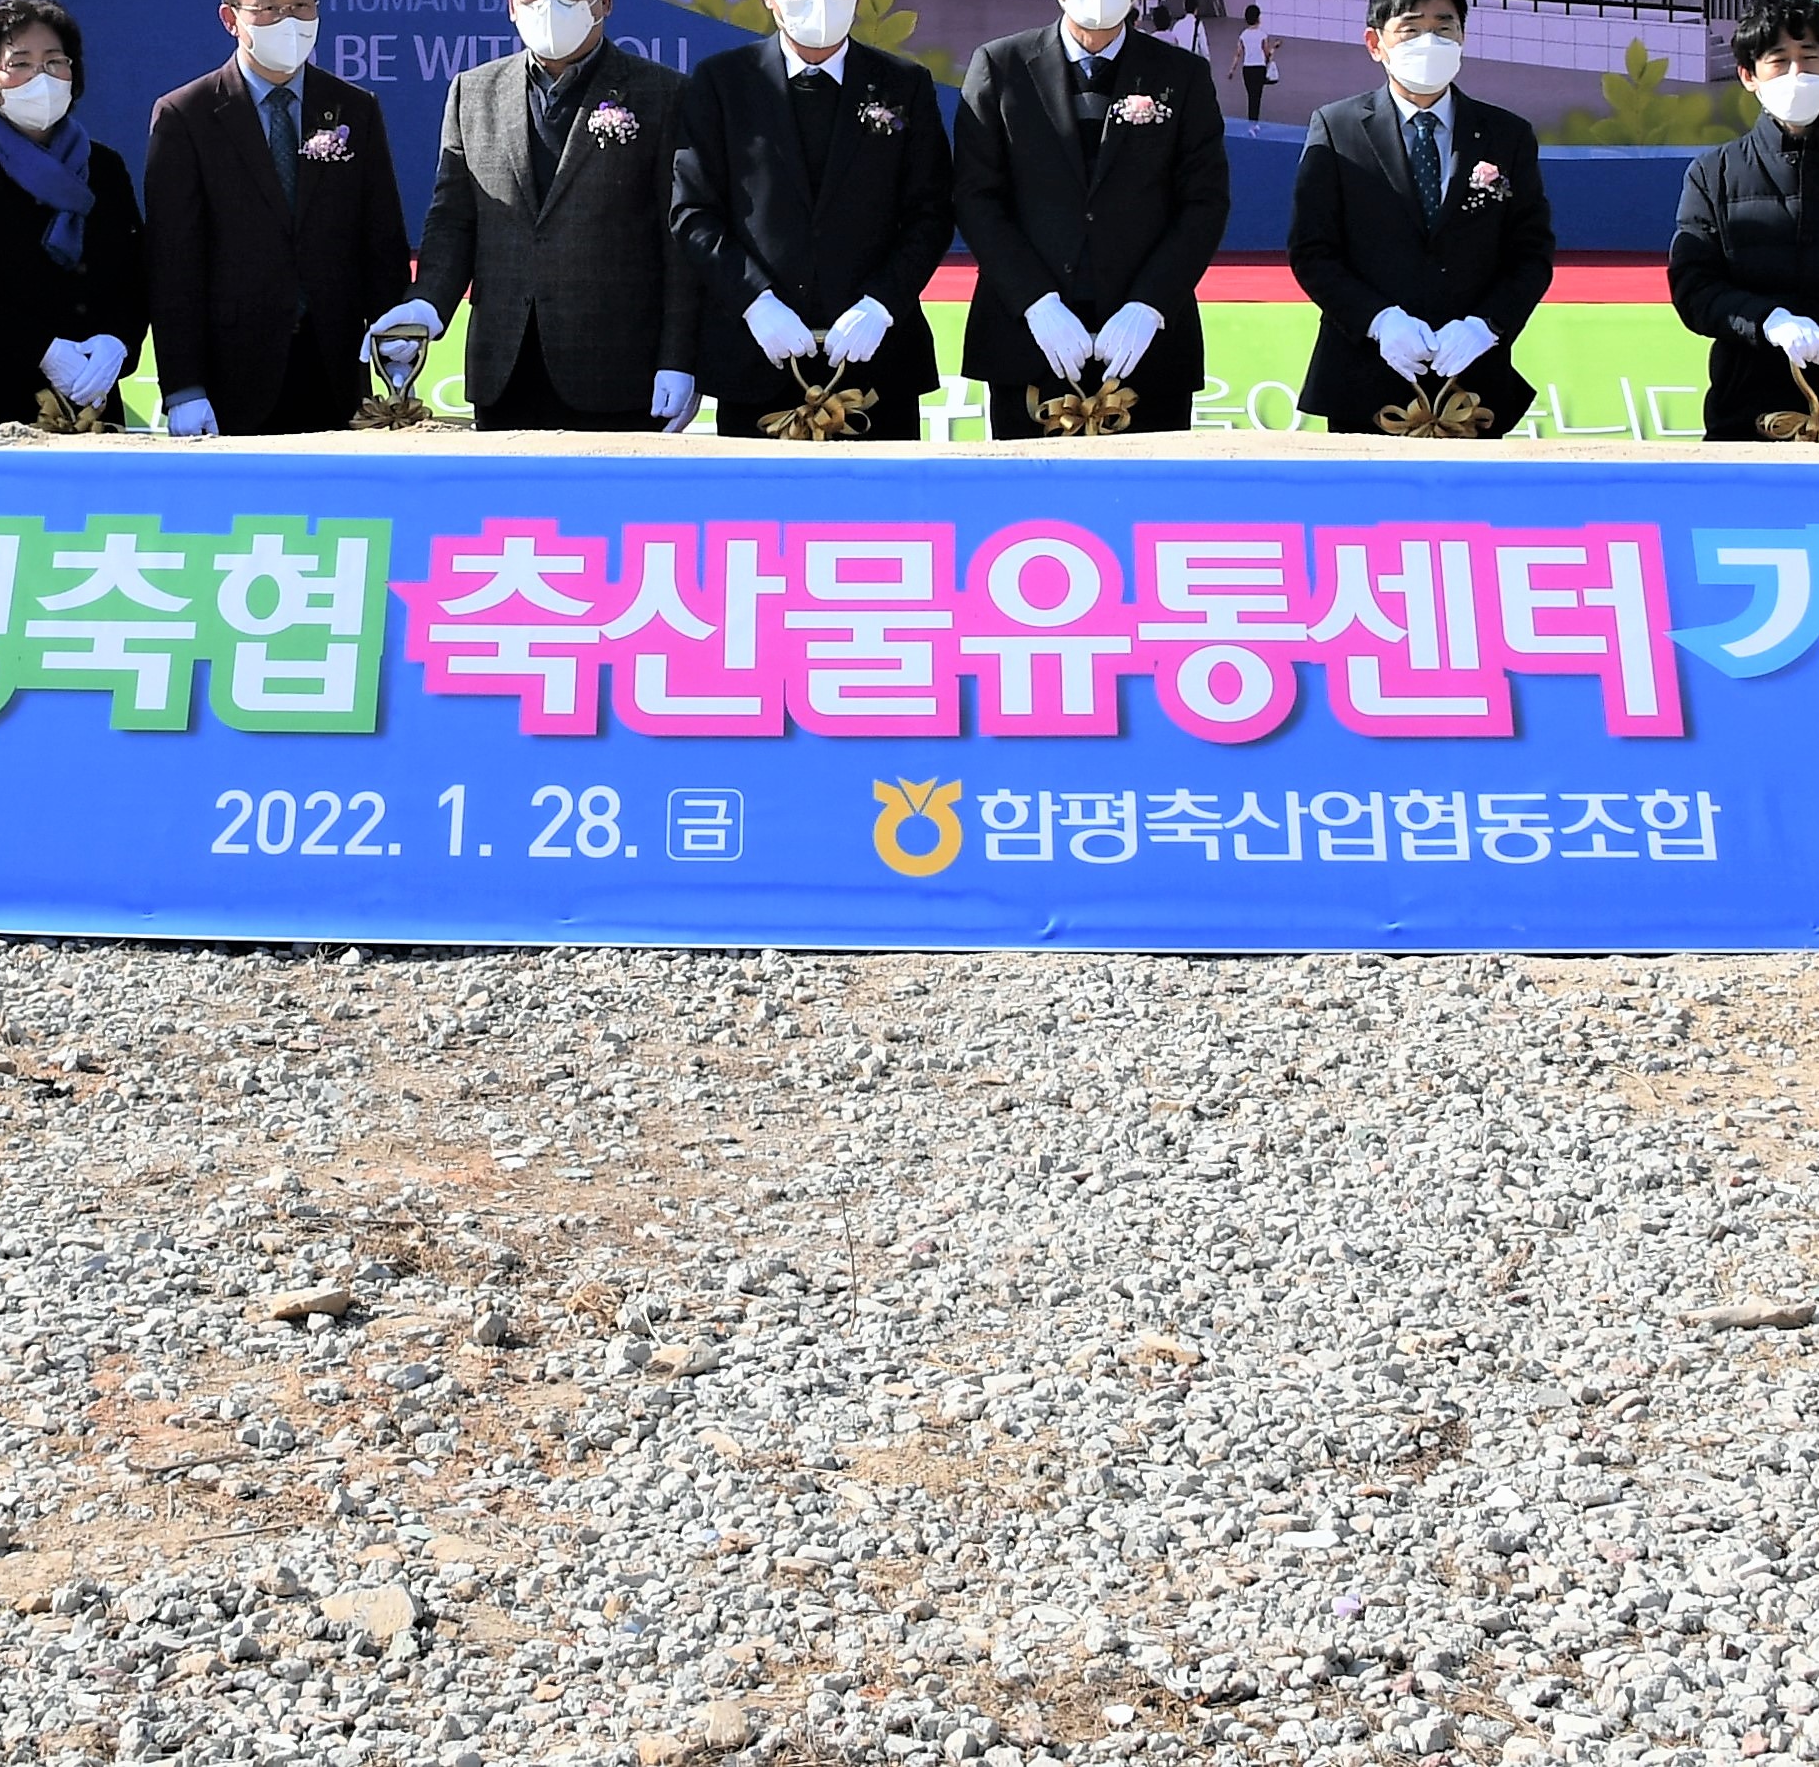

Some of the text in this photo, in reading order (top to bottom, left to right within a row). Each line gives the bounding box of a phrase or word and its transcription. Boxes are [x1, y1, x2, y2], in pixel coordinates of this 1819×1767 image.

[335, 35, 398, 81] BE
[413, 35, 522, 81] WIT
[426, 537, 1662, 724] 축산물유통센터
[212, 786, 401, 857] 2022.
[437, 784, 491, 857] 1.
[527, 784, 639, 859] 28.
[980, 787, 1721, 866] 함평축산업협동조합
